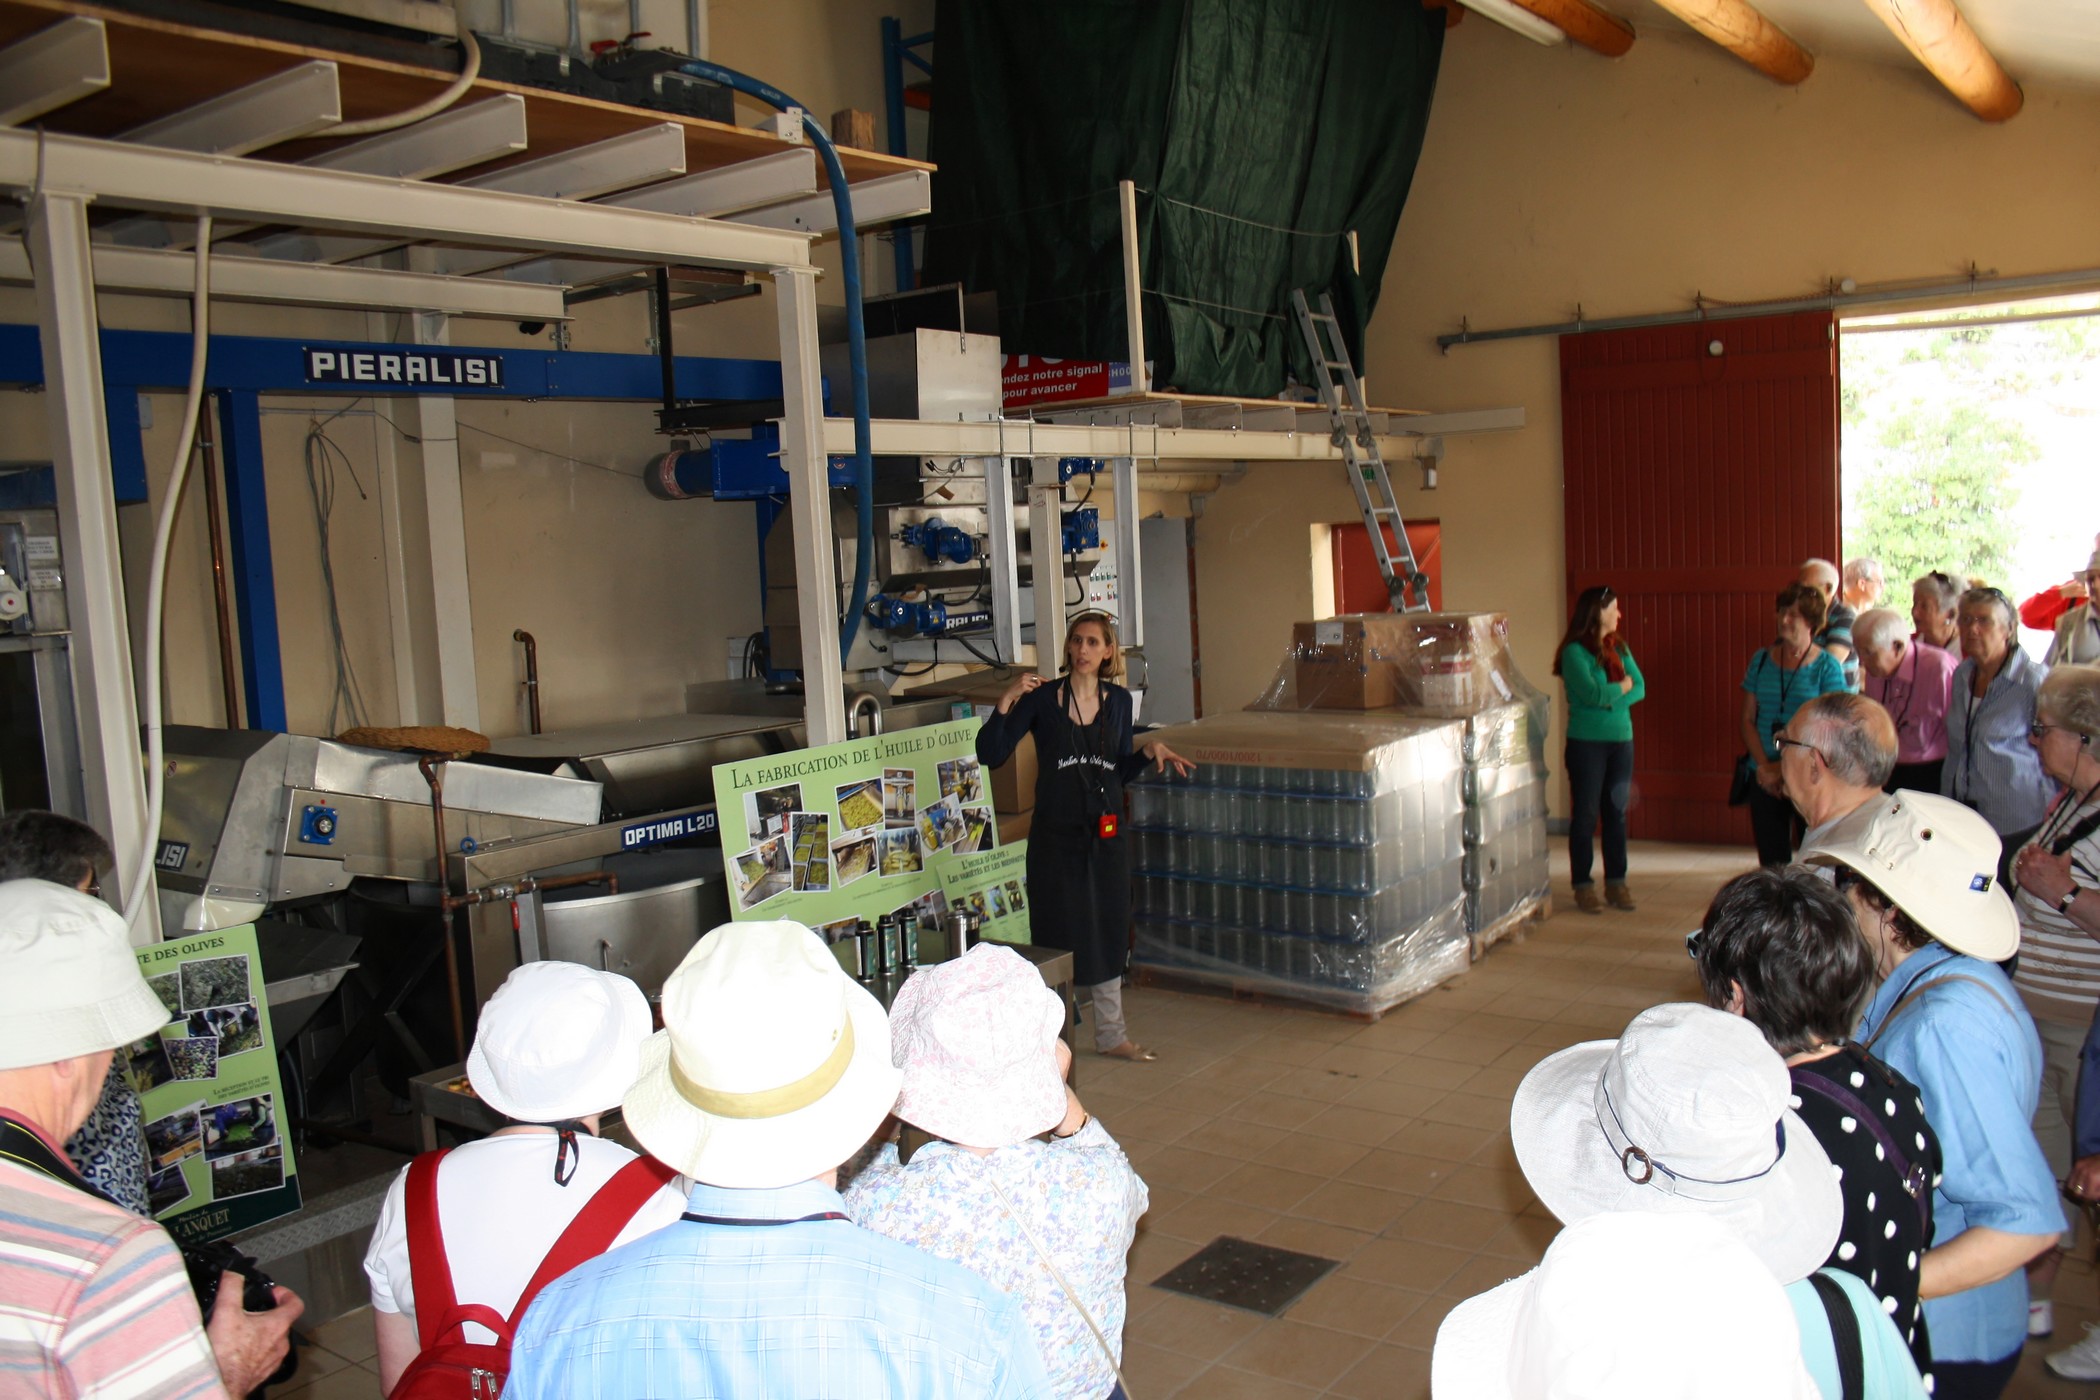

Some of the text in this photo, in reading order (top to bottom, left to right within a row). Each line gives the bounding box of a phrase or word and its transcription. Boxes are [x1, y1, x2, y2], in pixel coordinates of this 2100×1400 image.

[311, 352, 498, 384] PIERALISI
[1001, 363, 1102, 384] ndez notre signal
[1002, 382, 1077, 400] pour avancer
[758, 754, 849, 784] FABRICATION
[853, 748, 871, 764] DE
[875, 739, 923, 760] L'HUILE
[927, 729, 973, 750] D'OLIVE
[625, 813, 715, 845] OPTIMA L20
[156, 844, 186, 867] ISI
[155, 947, 178, 960] DES
[182, 937, 225, 954] OLIVES
